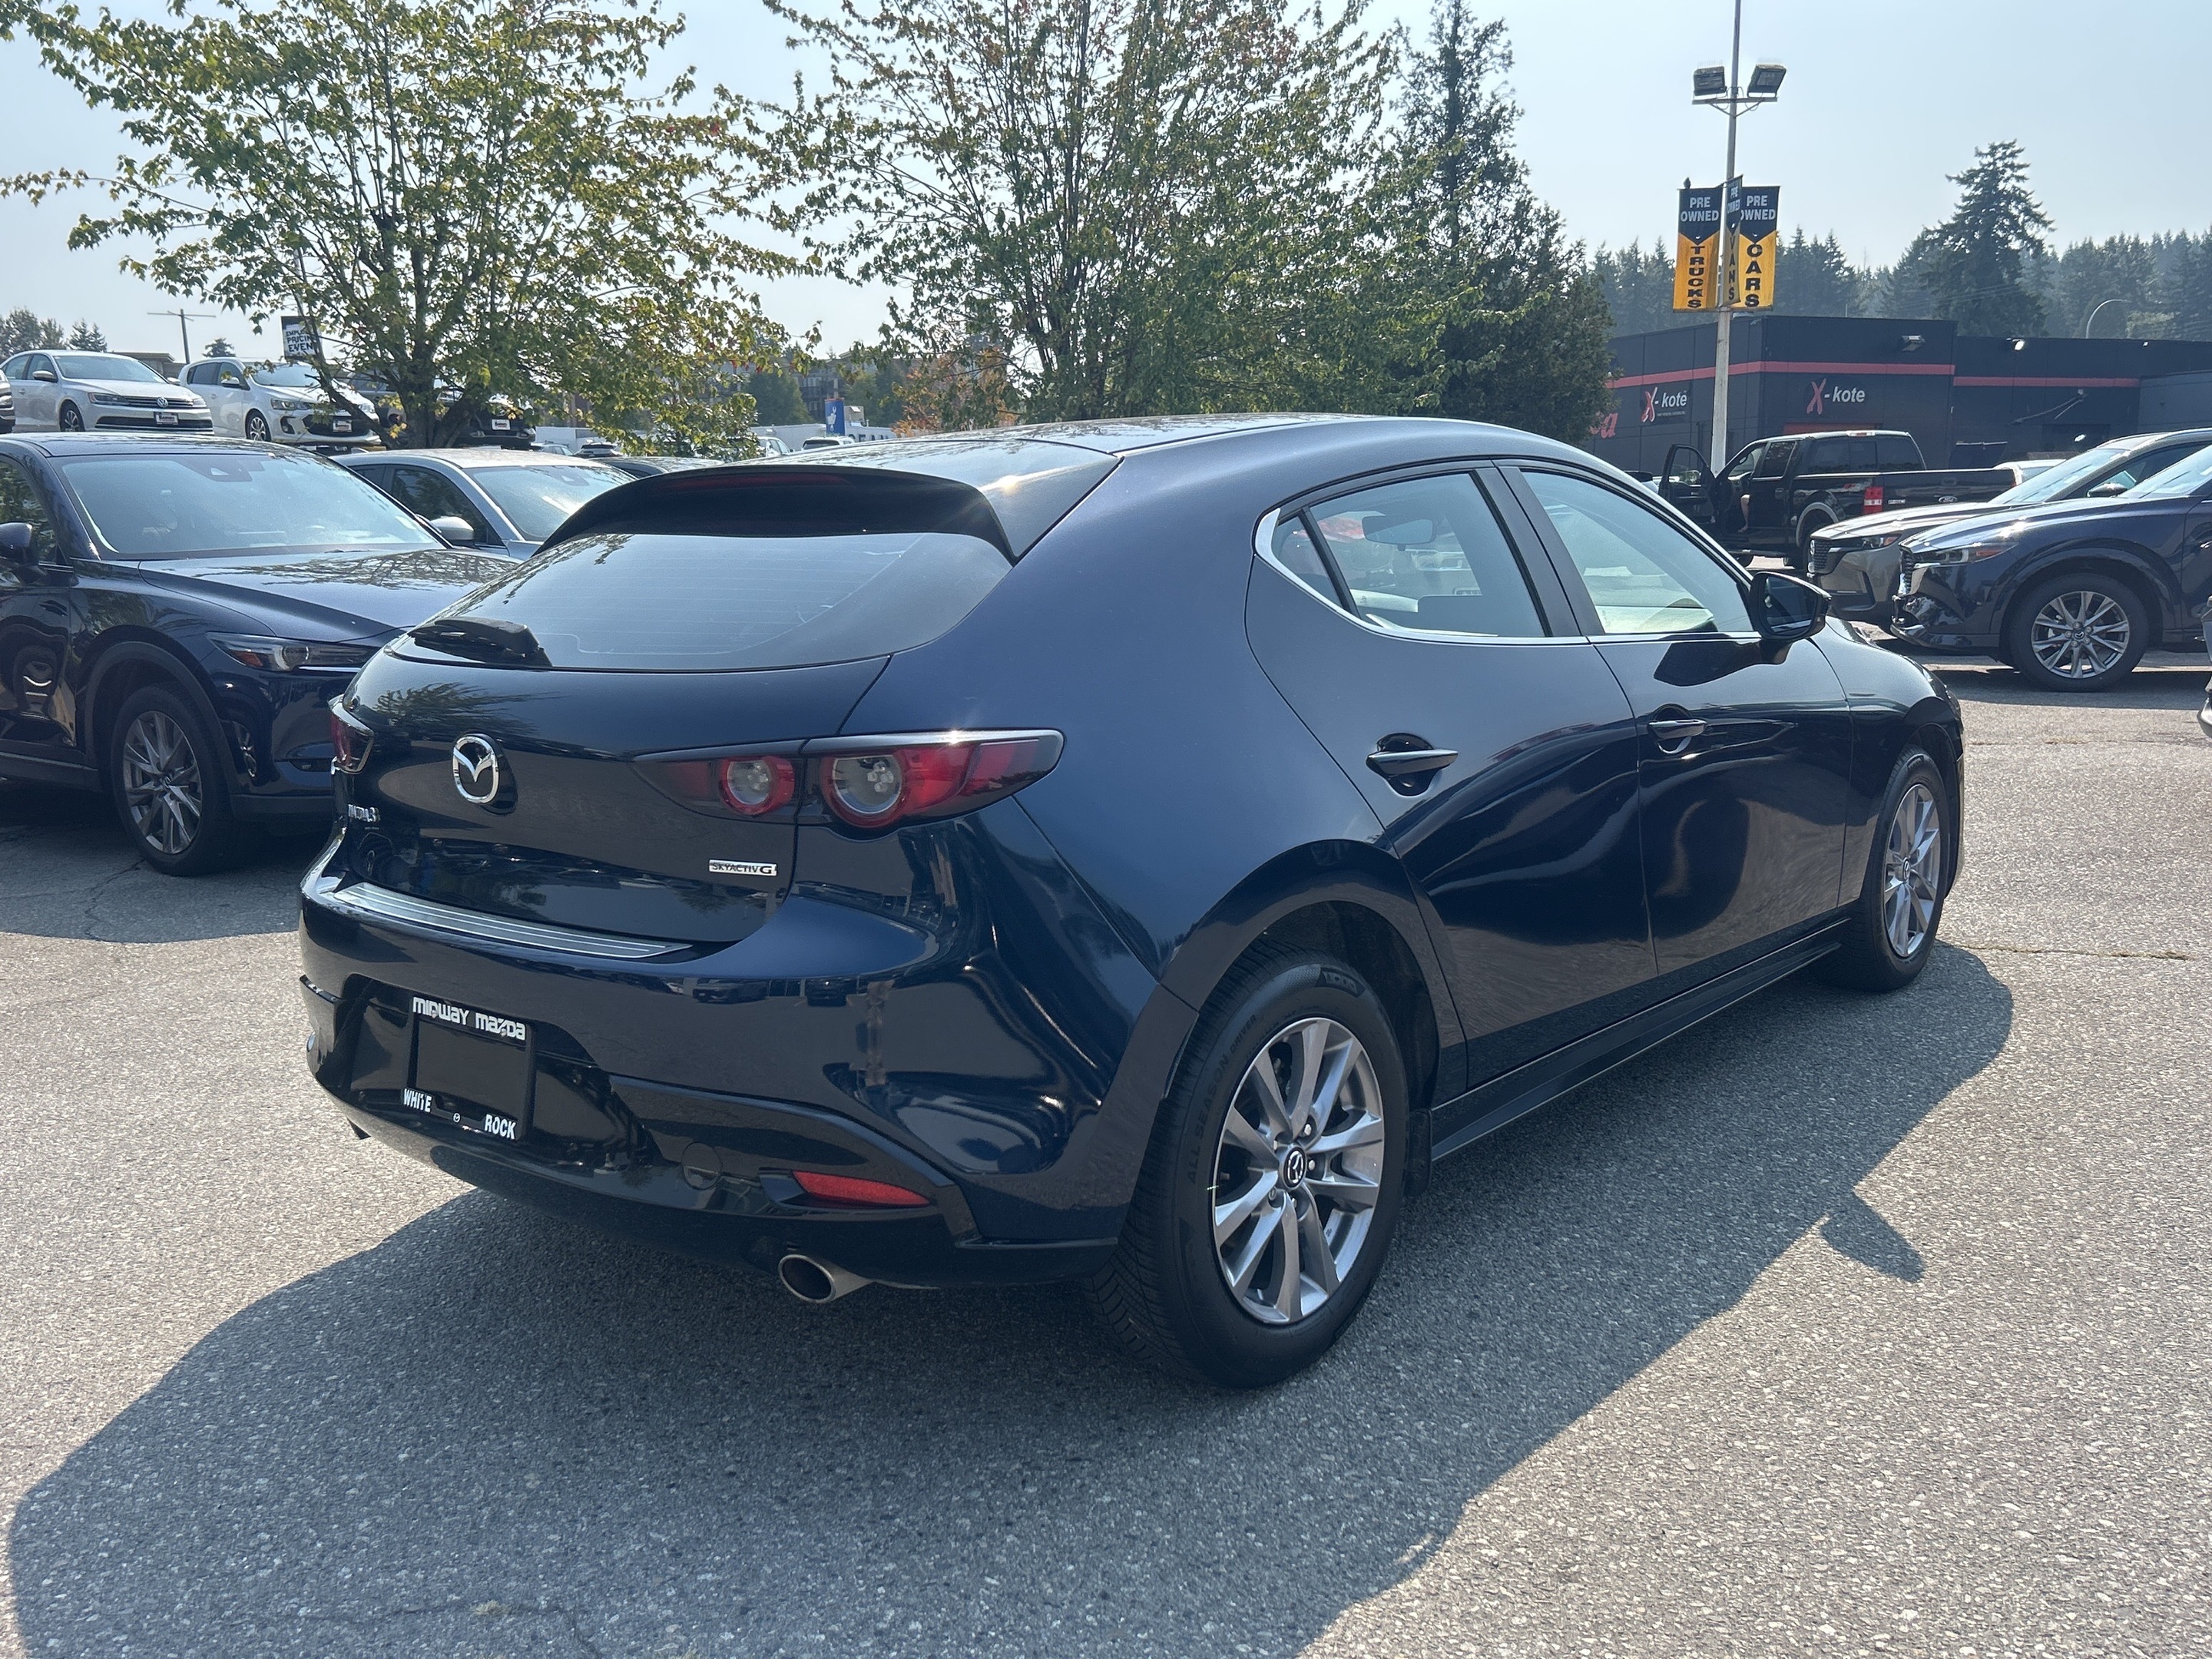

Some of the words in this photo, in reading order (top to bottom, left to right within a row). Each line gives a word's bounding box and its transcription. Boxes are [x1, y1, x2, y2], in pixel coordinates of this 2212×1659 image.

[1681, 210, 1720, 222] OWNED
[1690, 197, 1711, 208] PRE
[1746, 195, 1768, 207] PRE
[1687, 246, 1705, 308] TRUCKS
[1745, 244, 1763, 307] CARS
[288, 343, 313, 353] EVEN
[1194, 1053, 1229, 1139] SEASON
[1230, 1014, 1257, 1055] DRIVER
[403, 1088, 432, 1112] WHITE
[484, 1114, 516, 1140] ROCK
